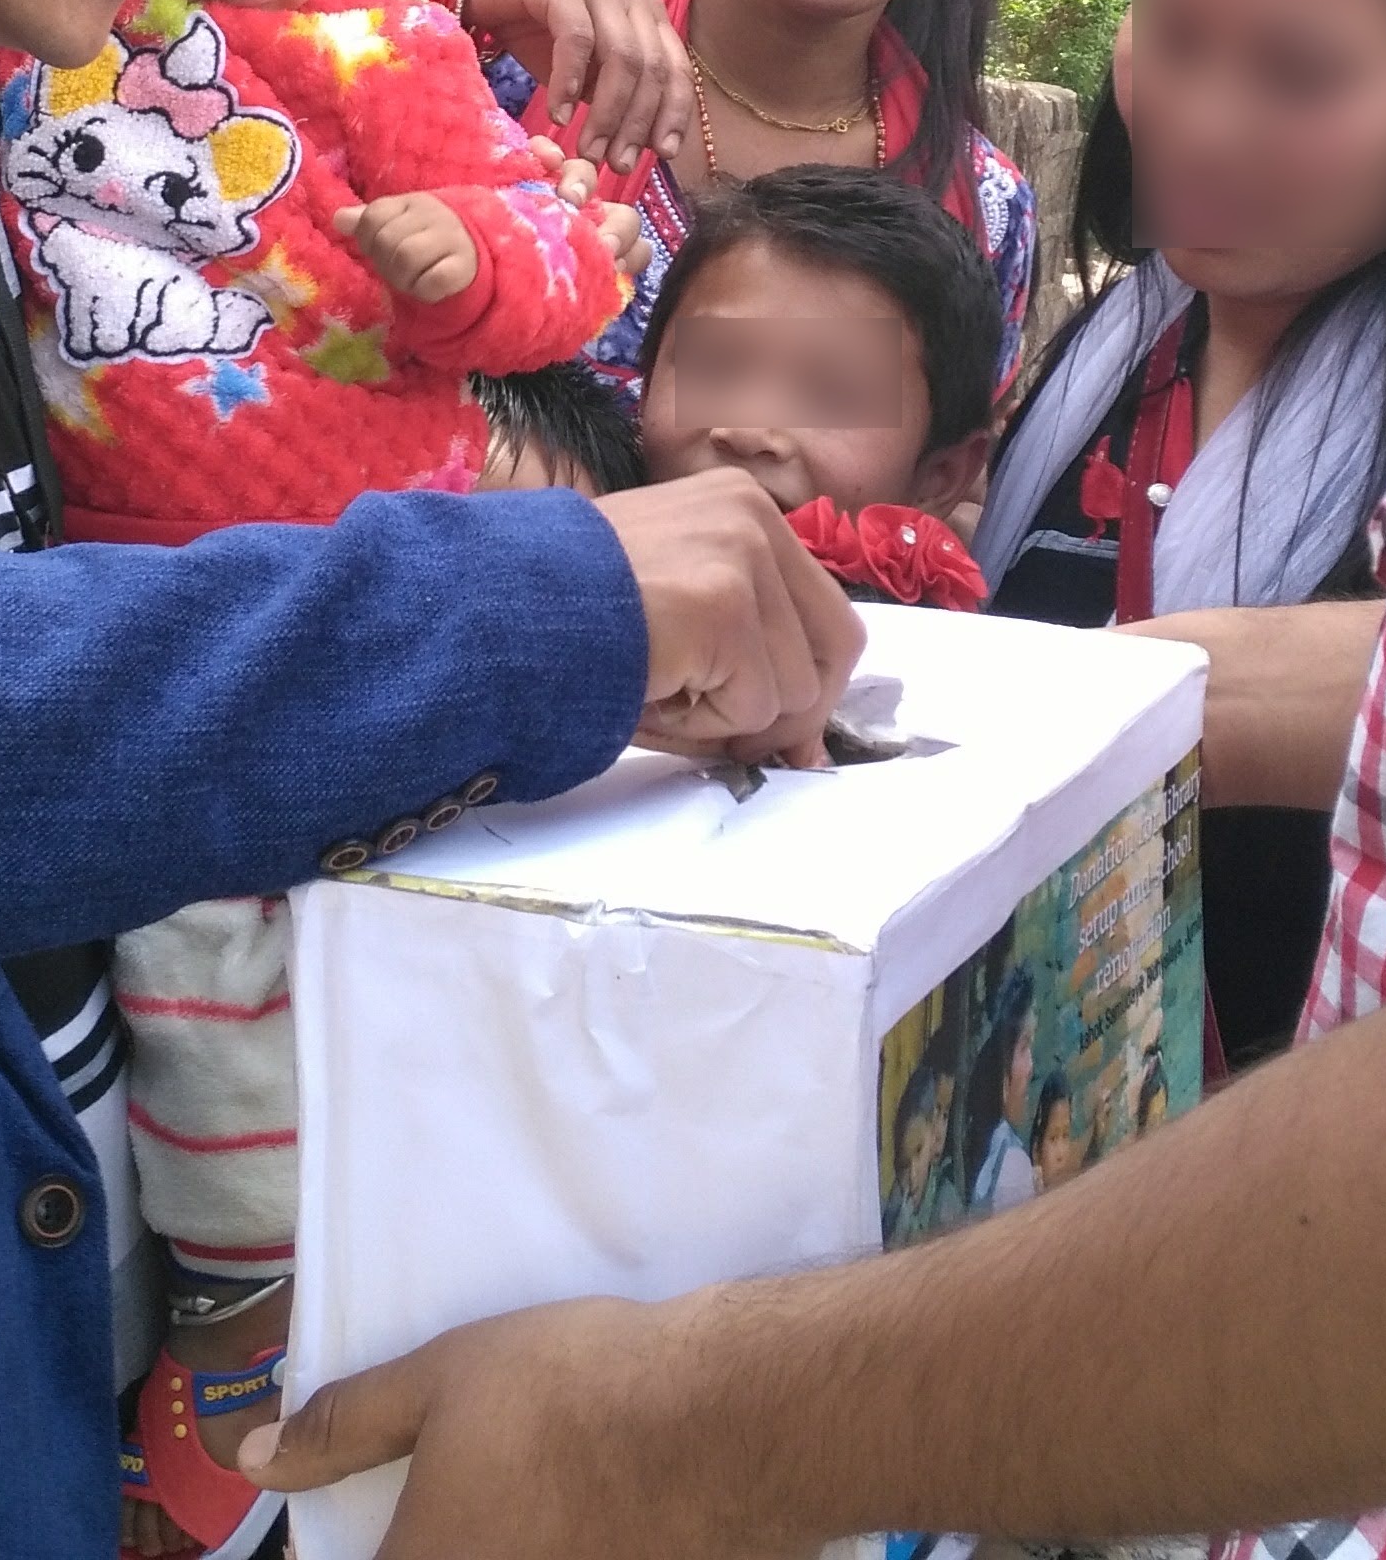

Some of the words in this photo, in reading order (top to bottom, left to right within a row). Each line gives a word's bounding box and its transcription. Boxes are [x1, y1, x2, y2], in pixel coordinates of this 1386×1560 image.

[1068, 835, 1132, 909] Donation
[1163, 767, 1201, 826] library
[1079, 899, 1119, 954] setup
[1123, 863, 1154, 914] and
[1155, 819, 1193, 889] school
[1095, 905, 1171, 995] renovation
[204, 1373, 269, 1401] SPORT
